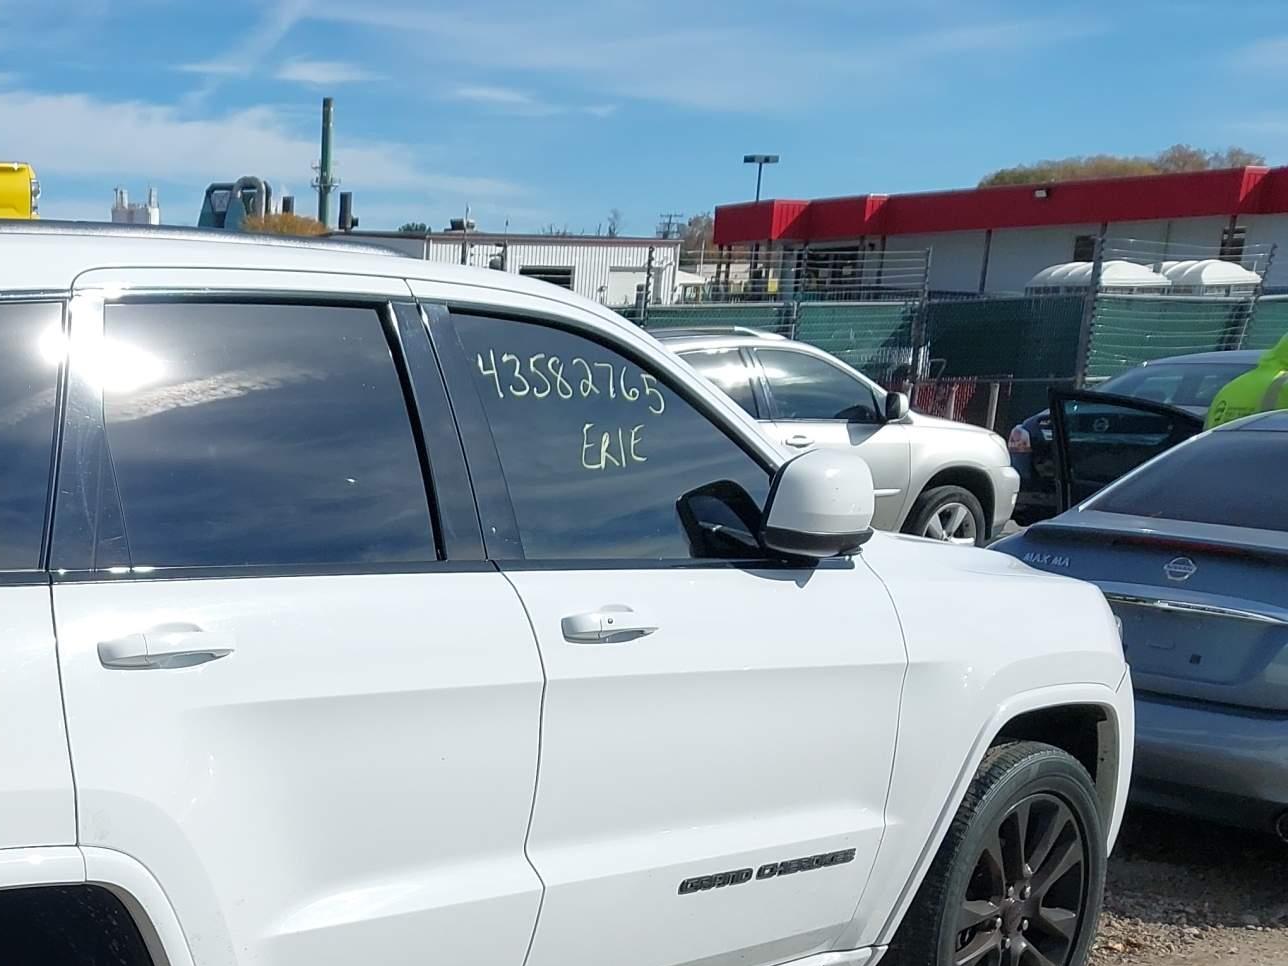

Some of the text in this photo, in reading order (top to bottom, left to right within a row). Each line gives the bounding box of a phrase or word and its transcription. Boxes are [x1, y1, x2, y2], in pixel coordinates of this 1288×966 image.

[477, 349, 665, 414] 43582765
[582, 423, 648, 470] ERIE
[1022, 552, 1070, 568] MAXMA
[678, 851, 857, 895] GRAND CHEROKEE
